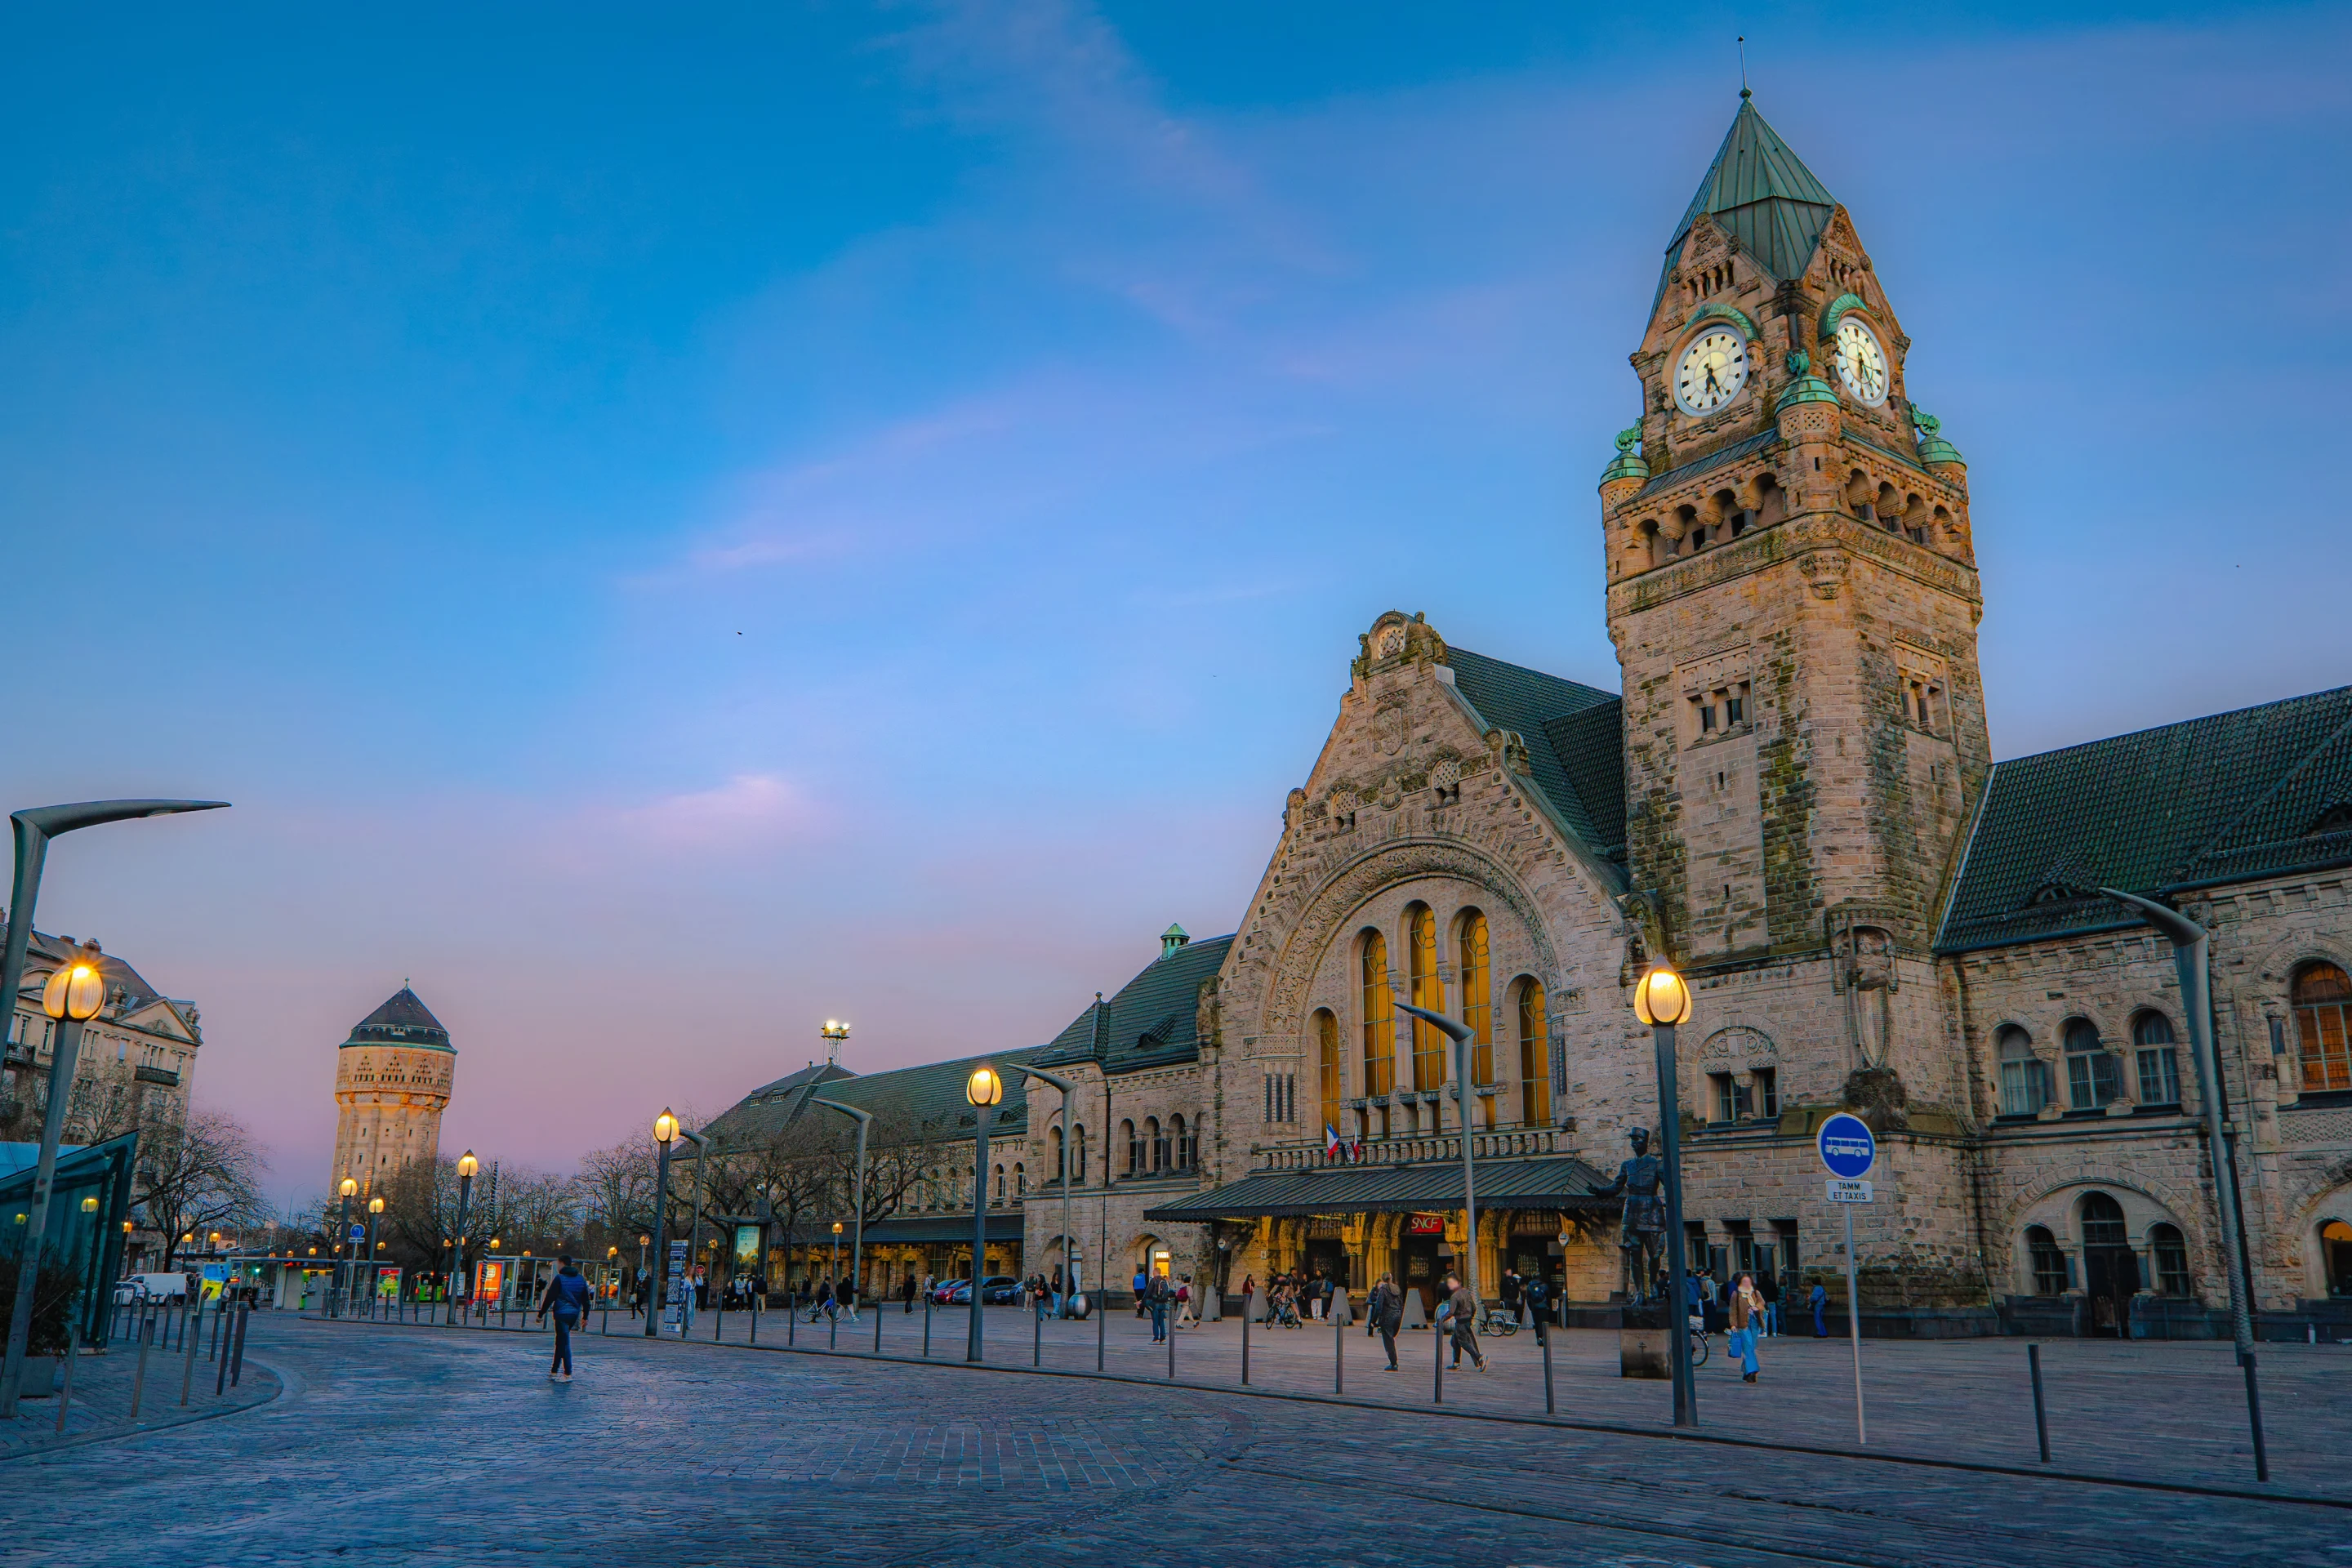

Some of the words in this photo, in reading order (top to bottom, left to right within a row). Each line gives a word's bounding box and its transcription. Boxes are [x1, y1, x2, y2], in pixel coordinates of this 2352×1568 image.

[1838, 1183, 1860, 1191] TAMM
[1845, 1192, 1867, 1200] TAXIS
[1411, 1217, 1440, 1229] SNCF
